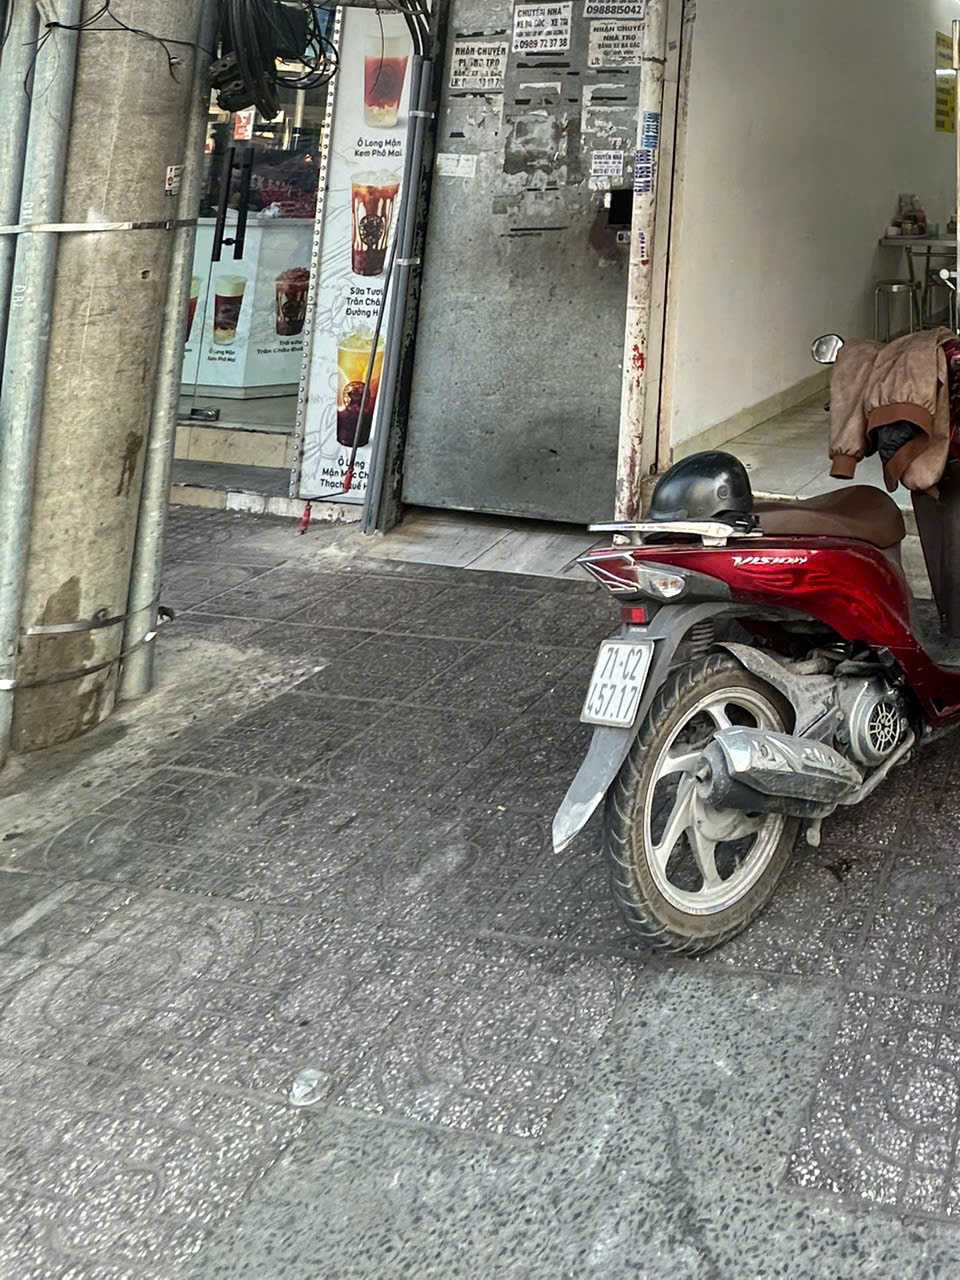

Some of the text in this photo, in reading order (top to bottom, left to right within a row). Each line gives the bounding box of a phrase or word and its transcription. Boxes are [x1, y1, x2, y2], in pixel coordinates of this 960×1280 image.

[364, 139, 383, 148] Long
[365, 298, 380, 306] Châ
[346, 459, 365, 470] Lng
[341, 470, 357, 478] Mc
[587, 682, 638, 720] 457.17
